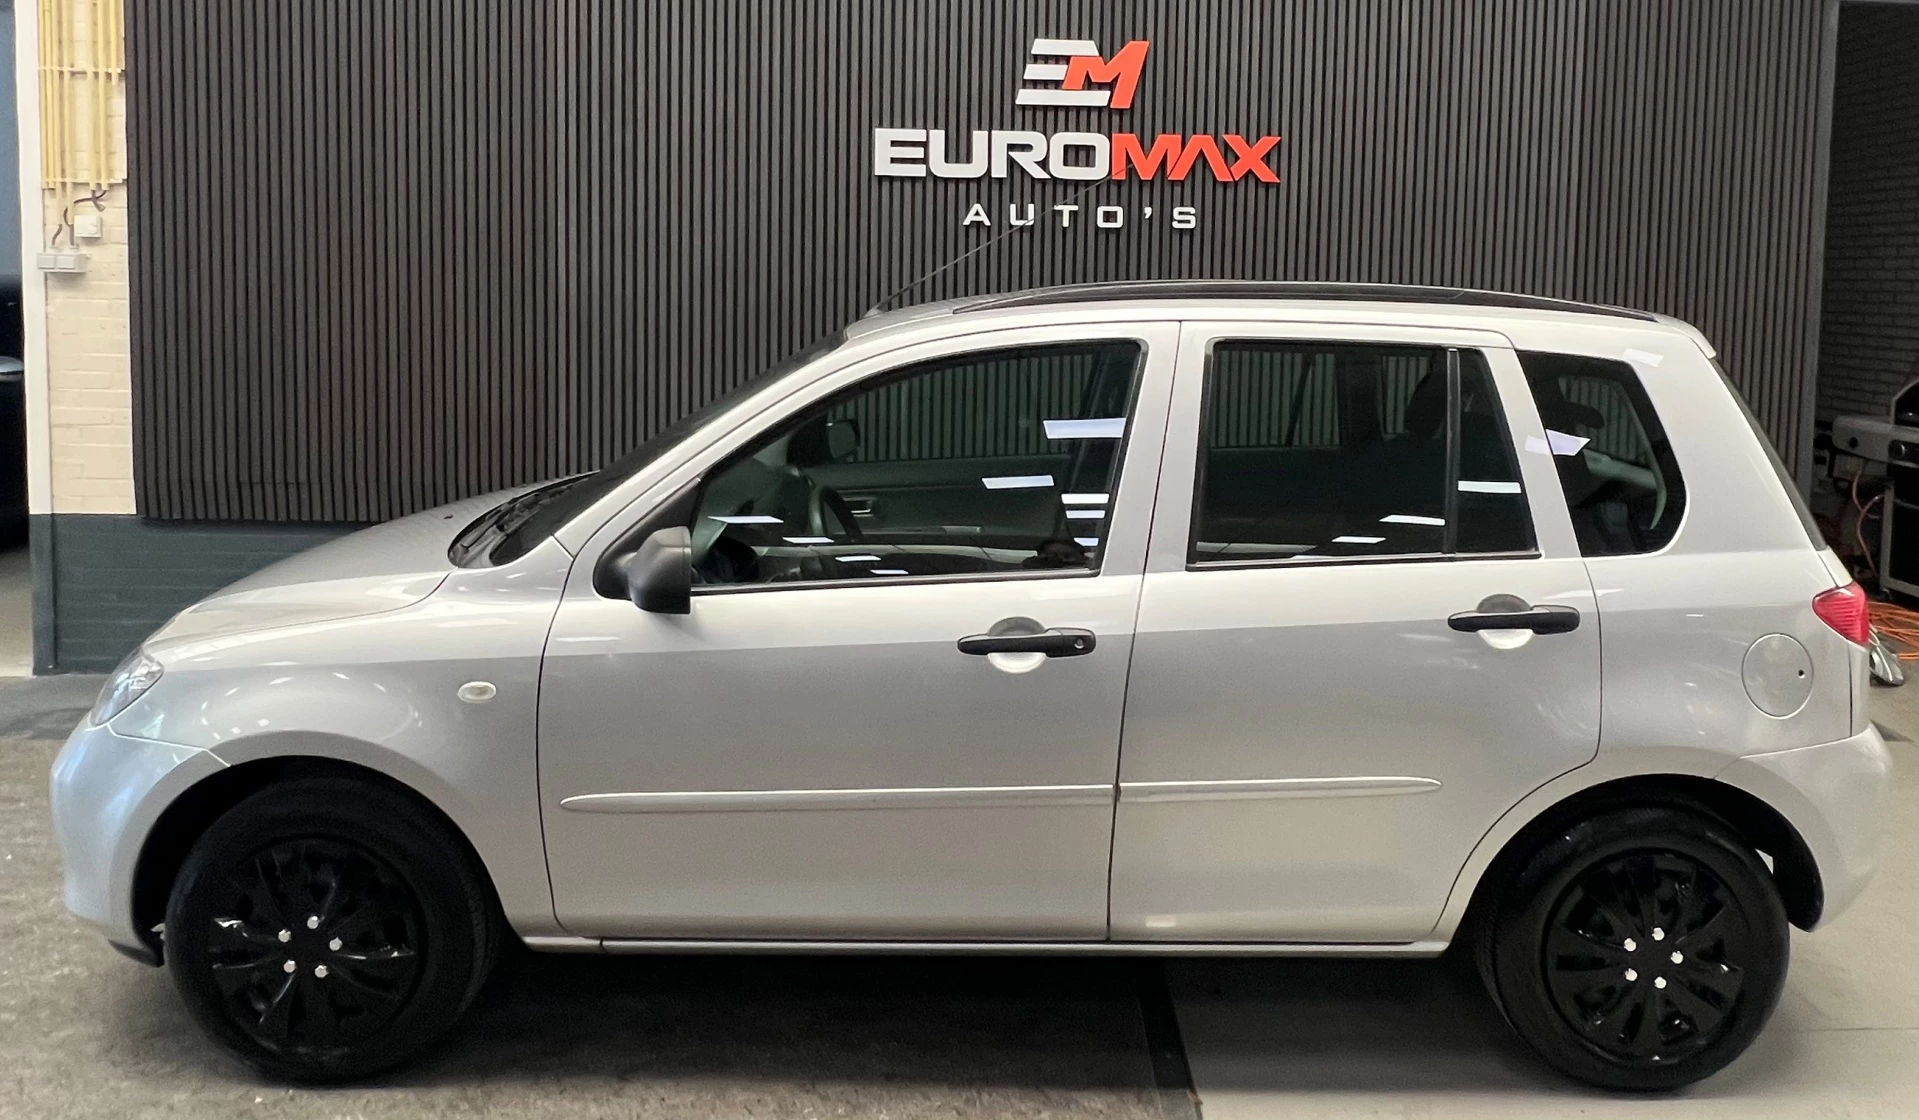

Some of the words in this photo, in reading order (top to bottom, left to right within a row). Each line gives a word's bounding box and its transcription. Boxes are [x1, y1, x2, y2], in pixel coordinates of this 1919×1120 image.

[1016, 38, 1149, 109] EM
[874, 128, 1281, 183] EUROMAX
[963, 203, 1197, 229] AUTO'S
